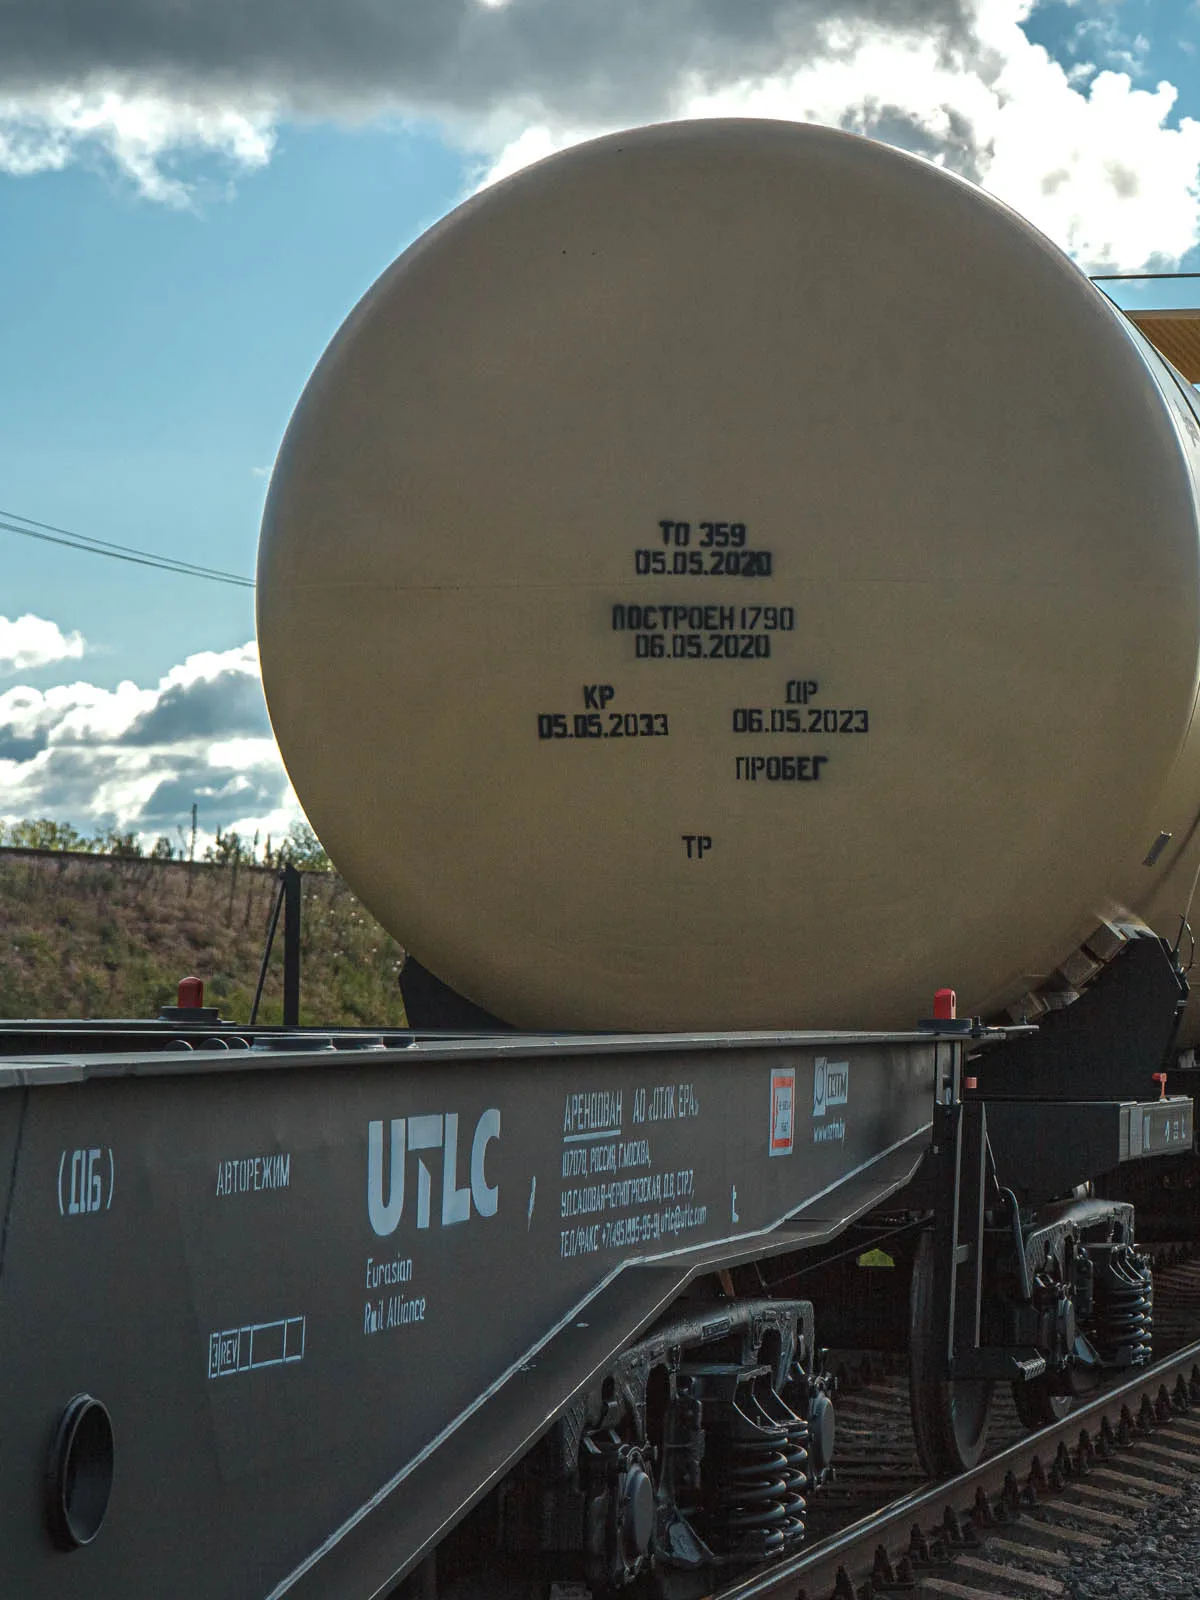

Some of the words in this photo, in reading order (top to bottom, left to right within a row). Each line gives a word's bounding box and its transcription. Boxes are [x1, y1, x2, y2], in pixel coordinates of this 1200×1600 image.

[659, 520, 690, 546] ТО
[699, 523, 746, 547] 359
[635, 551, 772, 577] 05.05.2020
[612, 604, 735, 632] ПОСТРОЕН
[740, 606, 795, 632] 1790
[635, 634, 770, 659] 06.05.2020
[583, 684, 615, 710] КР
[537, 713, 669, 740] 05.05.2033
[733, 708, 869, 734] 06.05.2023
[735, 756, 829, 782] ПРОБЕГ
[681, 835, 713, 859] ТР
[216, 1154, 291, 1197] АВТОРЕЖИМ
[368, 1108, 501, 1236] UTLC
[366, 1253, 412, 1289] Eurasian
[364, 1298, 384, 1336] Rail
[387, 1293, 426, 1328] Alliance
[221, 1337, 237, 1366] REV
